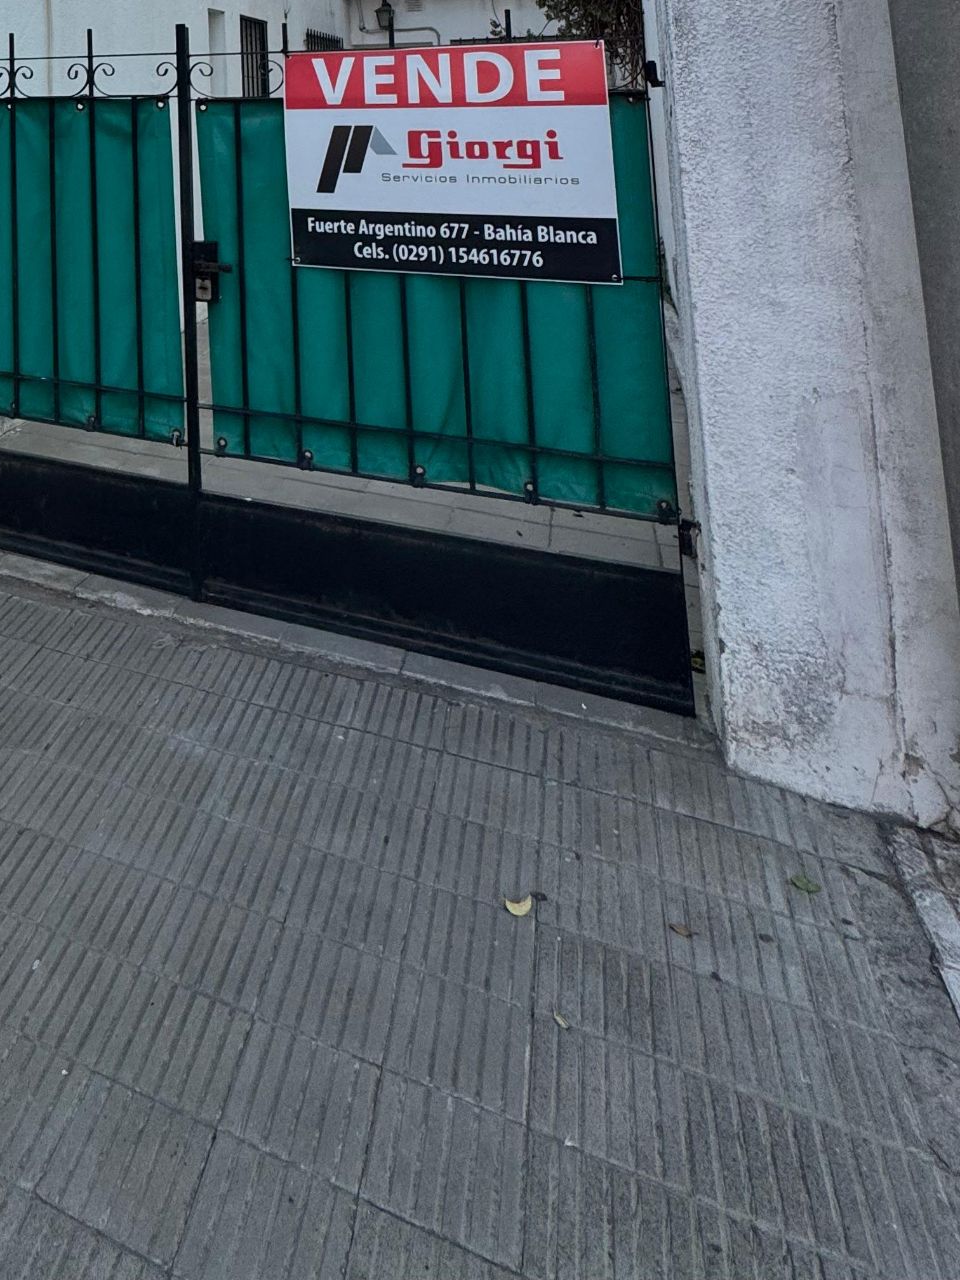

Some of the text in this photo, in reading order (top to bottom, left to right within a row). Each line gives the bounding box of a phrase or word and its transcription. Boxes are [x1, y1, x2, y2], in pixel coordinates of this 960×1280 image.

[311, 49, 565, 105] VENDE
[402, 129, 564, 169] Giorgi
[381, 172, 580, 185] Servicios Inmobiliarios
[307, 217, 355, 234] Fuerte
[358, 219, 436, 240] Argentino
[440, 223, 469, 239] 677
[484, 223, 533, 242] Bahía
[537, 225, 598, 244] Blanca
[353, 242, 544, 268] Cels. (0291) 154616776
